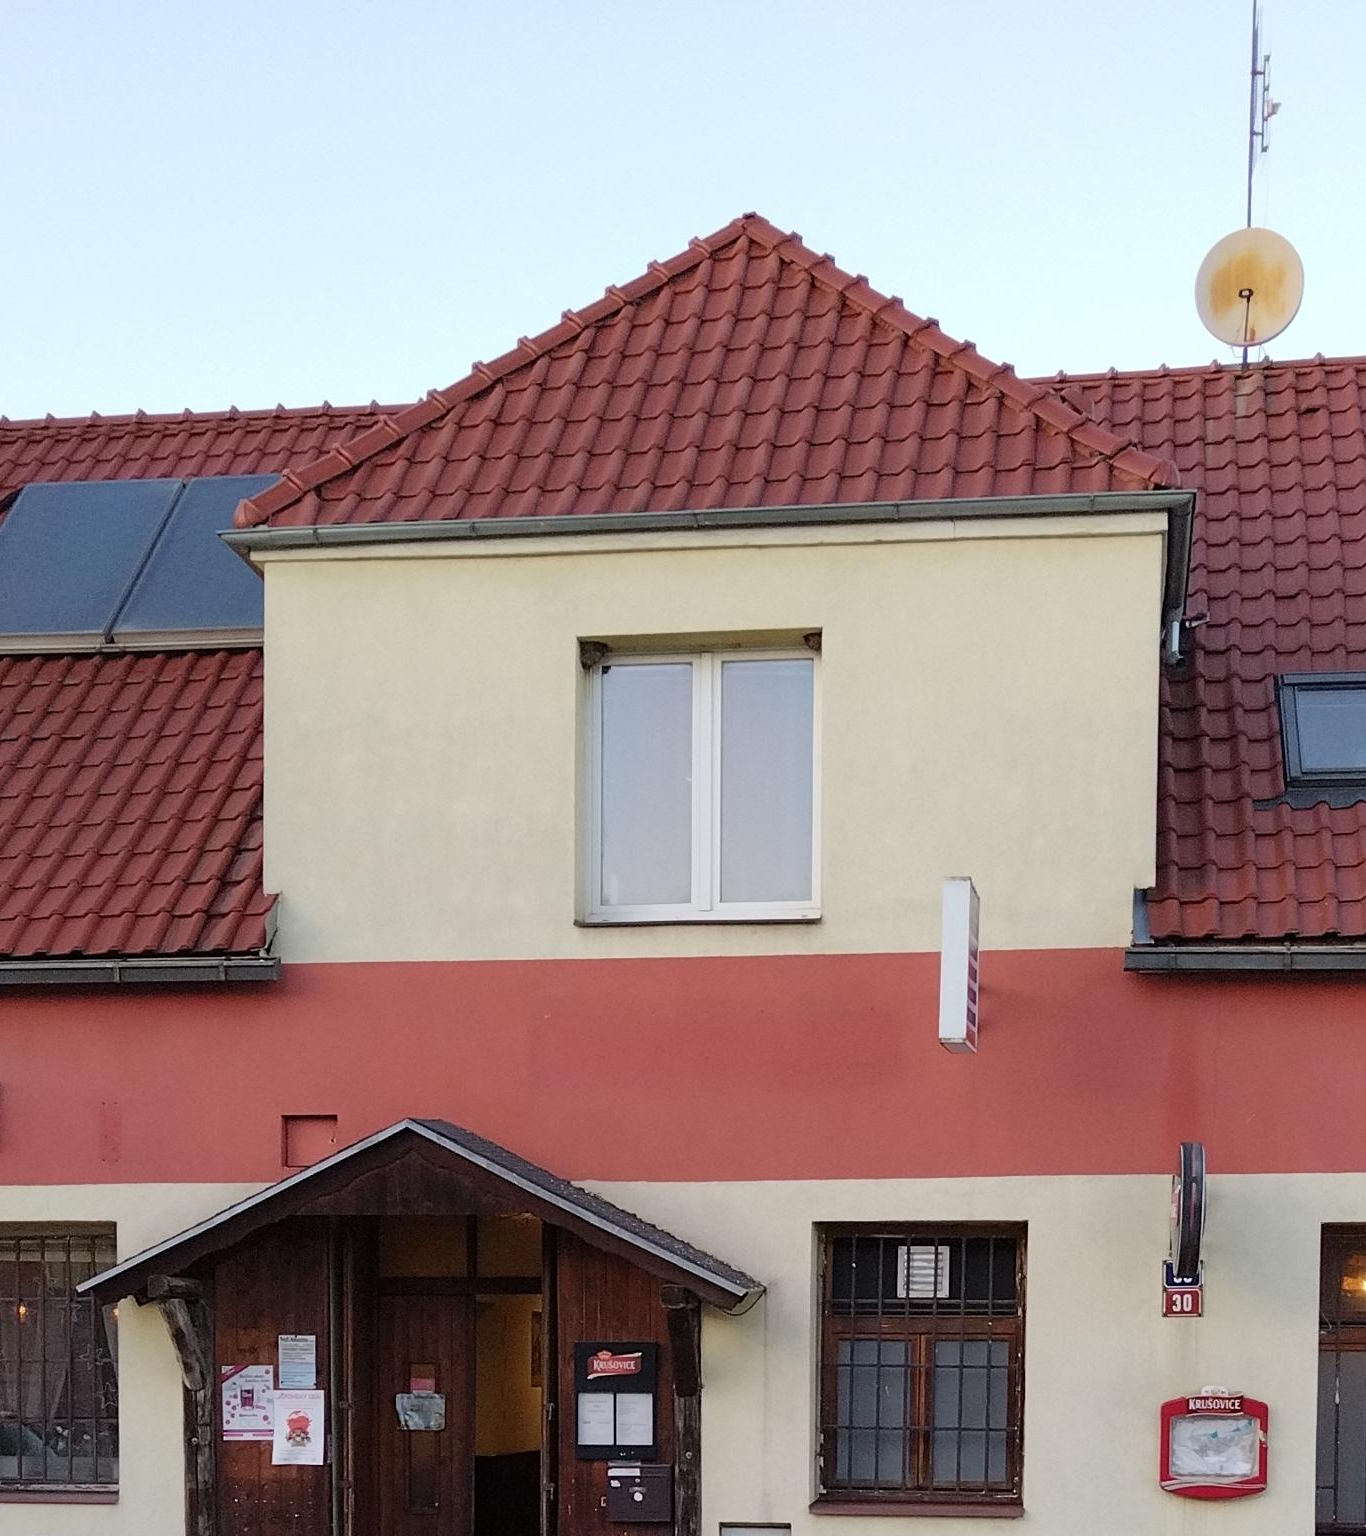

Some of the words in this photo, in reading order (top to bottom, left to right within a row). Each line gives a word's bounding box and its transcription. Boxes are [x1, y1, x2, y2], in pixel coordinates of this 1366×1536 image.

[1172, 1294, 1192, 1312] 30
[593, 1359, 636, 1372] KRUŠOVICE
[1188, 1397, 1241, 1410] KRUŠOVICE
